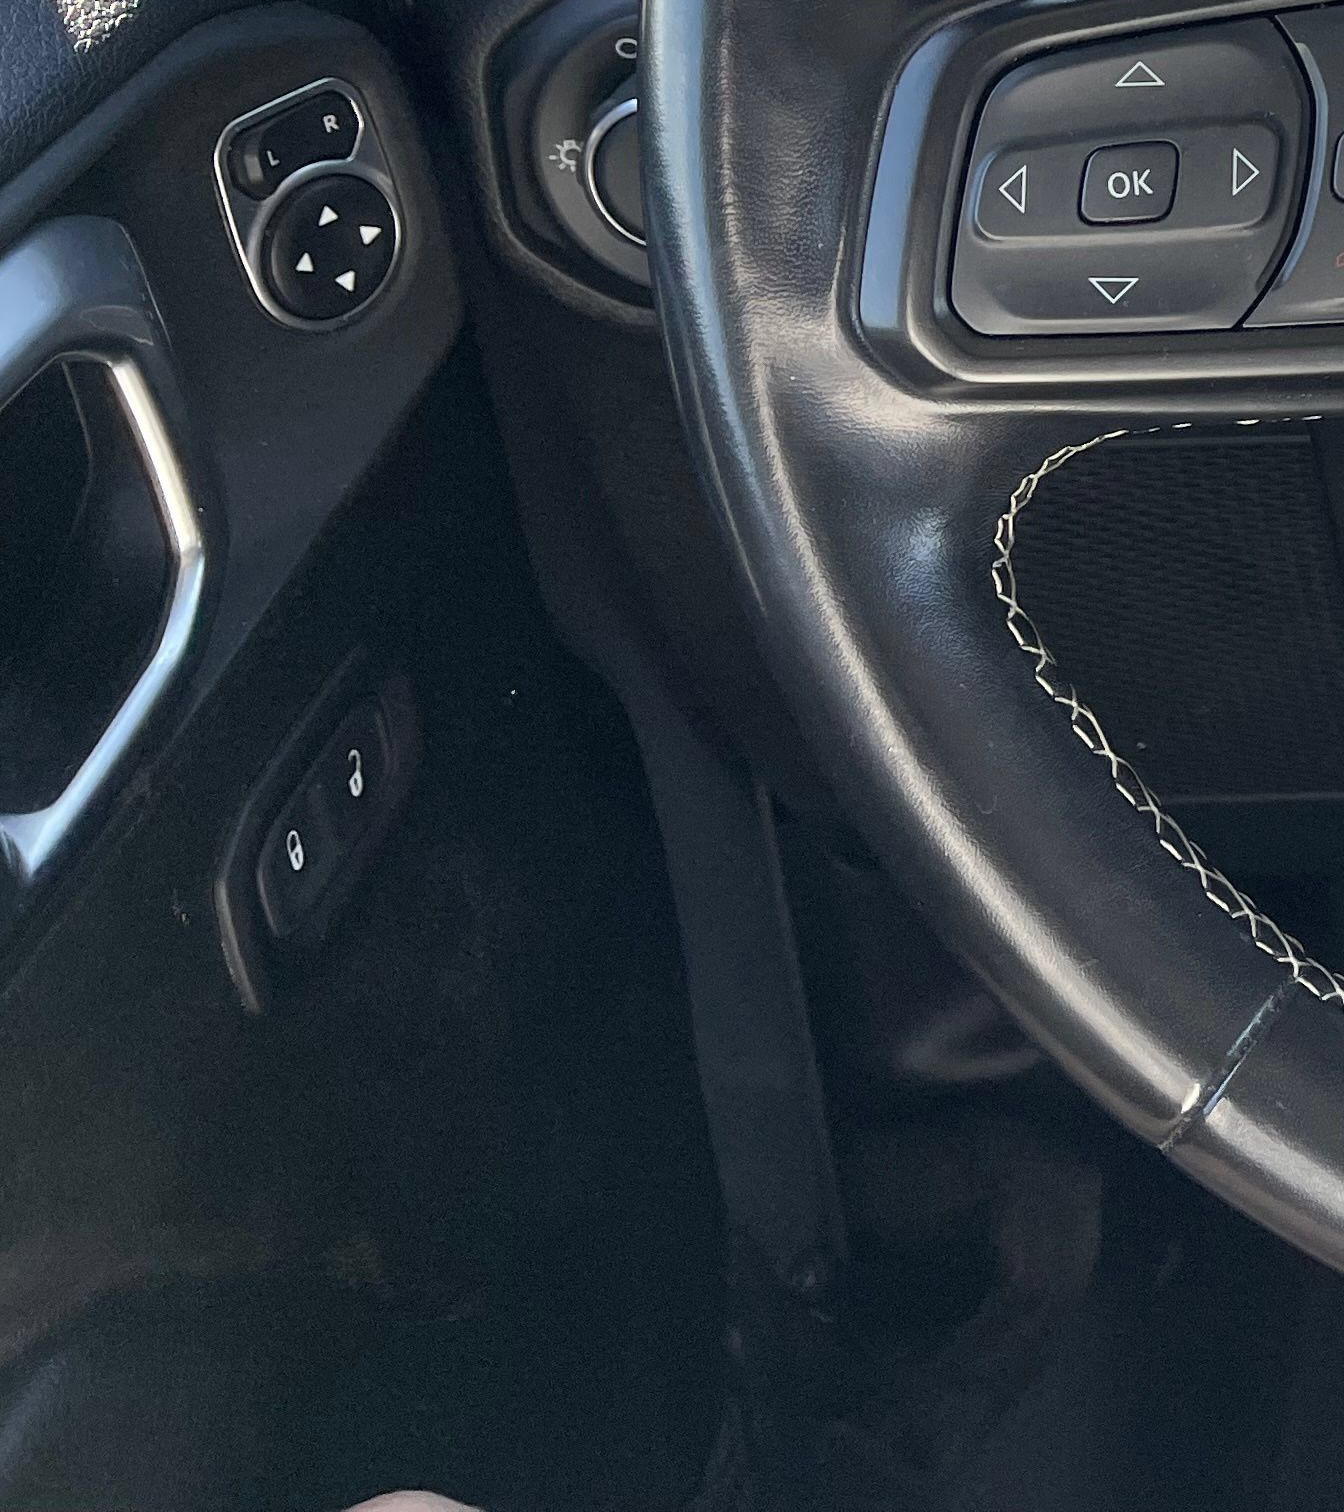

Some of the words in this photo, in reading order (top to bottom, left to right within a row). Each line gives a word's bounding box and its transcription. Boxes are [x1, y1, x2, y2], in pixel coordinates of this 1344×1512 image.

[323, 114, 340, 133] R
[268, 150, 280, 167] L
[1107, 170, 1154, 199] OK
